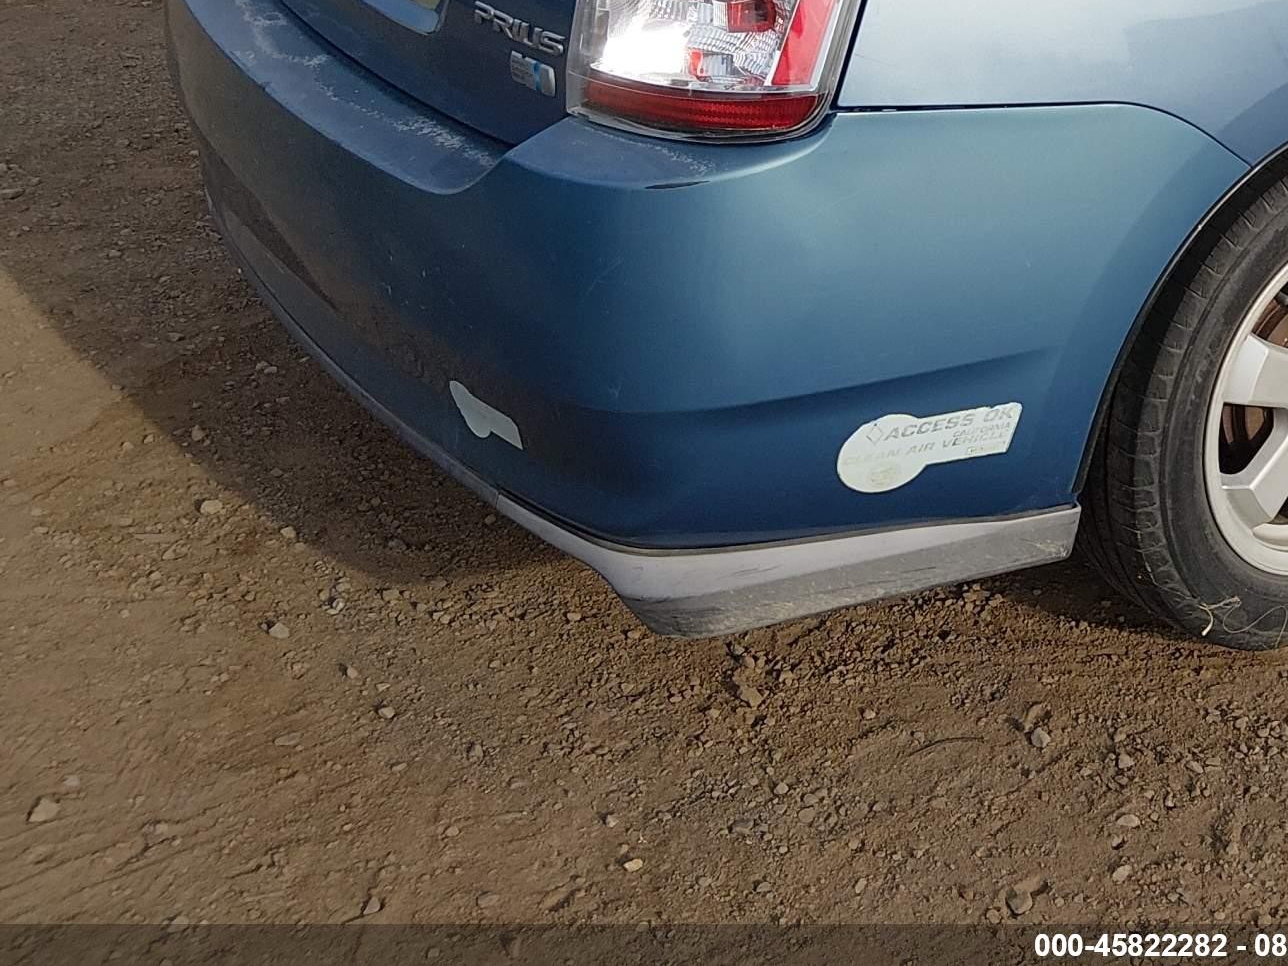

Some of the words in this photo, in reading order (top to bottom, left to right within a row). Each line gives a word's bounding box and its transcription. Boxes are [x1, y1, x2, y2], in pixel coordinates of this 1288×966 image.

[474, 0, 566, 56] PRIUS
[883, 414, 976, 442] ACCESS
[983, 406, 1014, 423] OK
[905, 441, 936, 456] AIR
